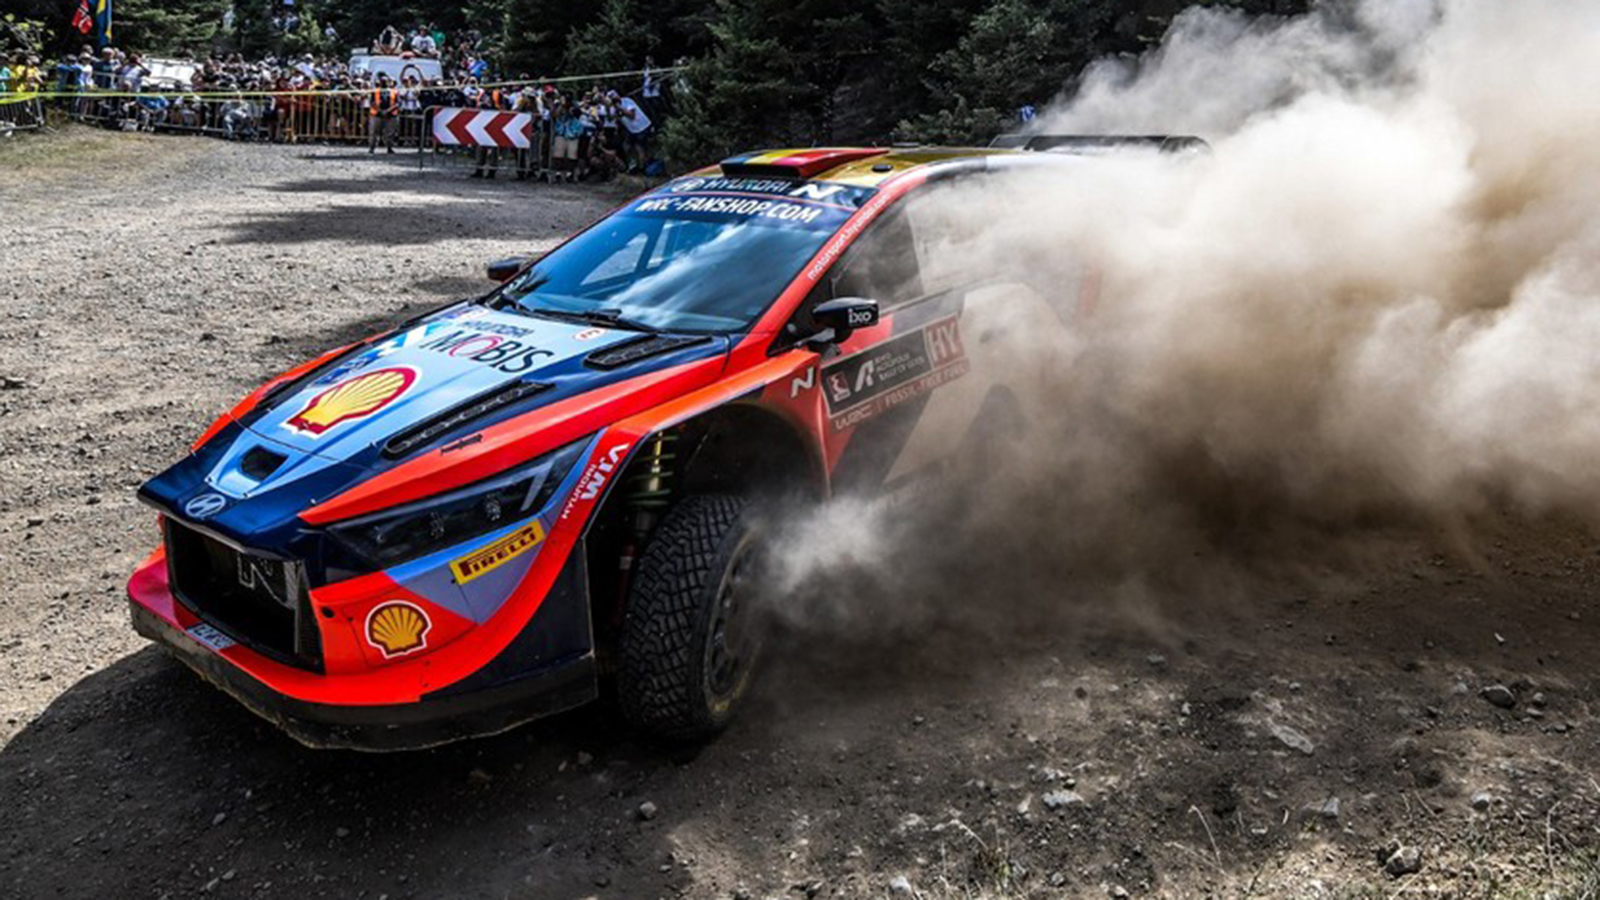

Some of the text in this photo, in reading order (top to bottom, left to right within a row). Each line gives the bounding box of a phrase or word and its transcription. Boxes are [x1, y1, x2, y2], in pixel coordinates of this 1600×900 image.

[704, 178, 847, 199] HYUNDAI N
[635, 197, 823, 223] WRC-FANSHOP.COM
[419, 330, 555, 373] MOBIS
[927, 322, 957, 362] HY
[791, 366, 815, 398] N
[561, 463, 598, 520] HYUNDAI
[458, 526, 537, 577] PIRELLI
